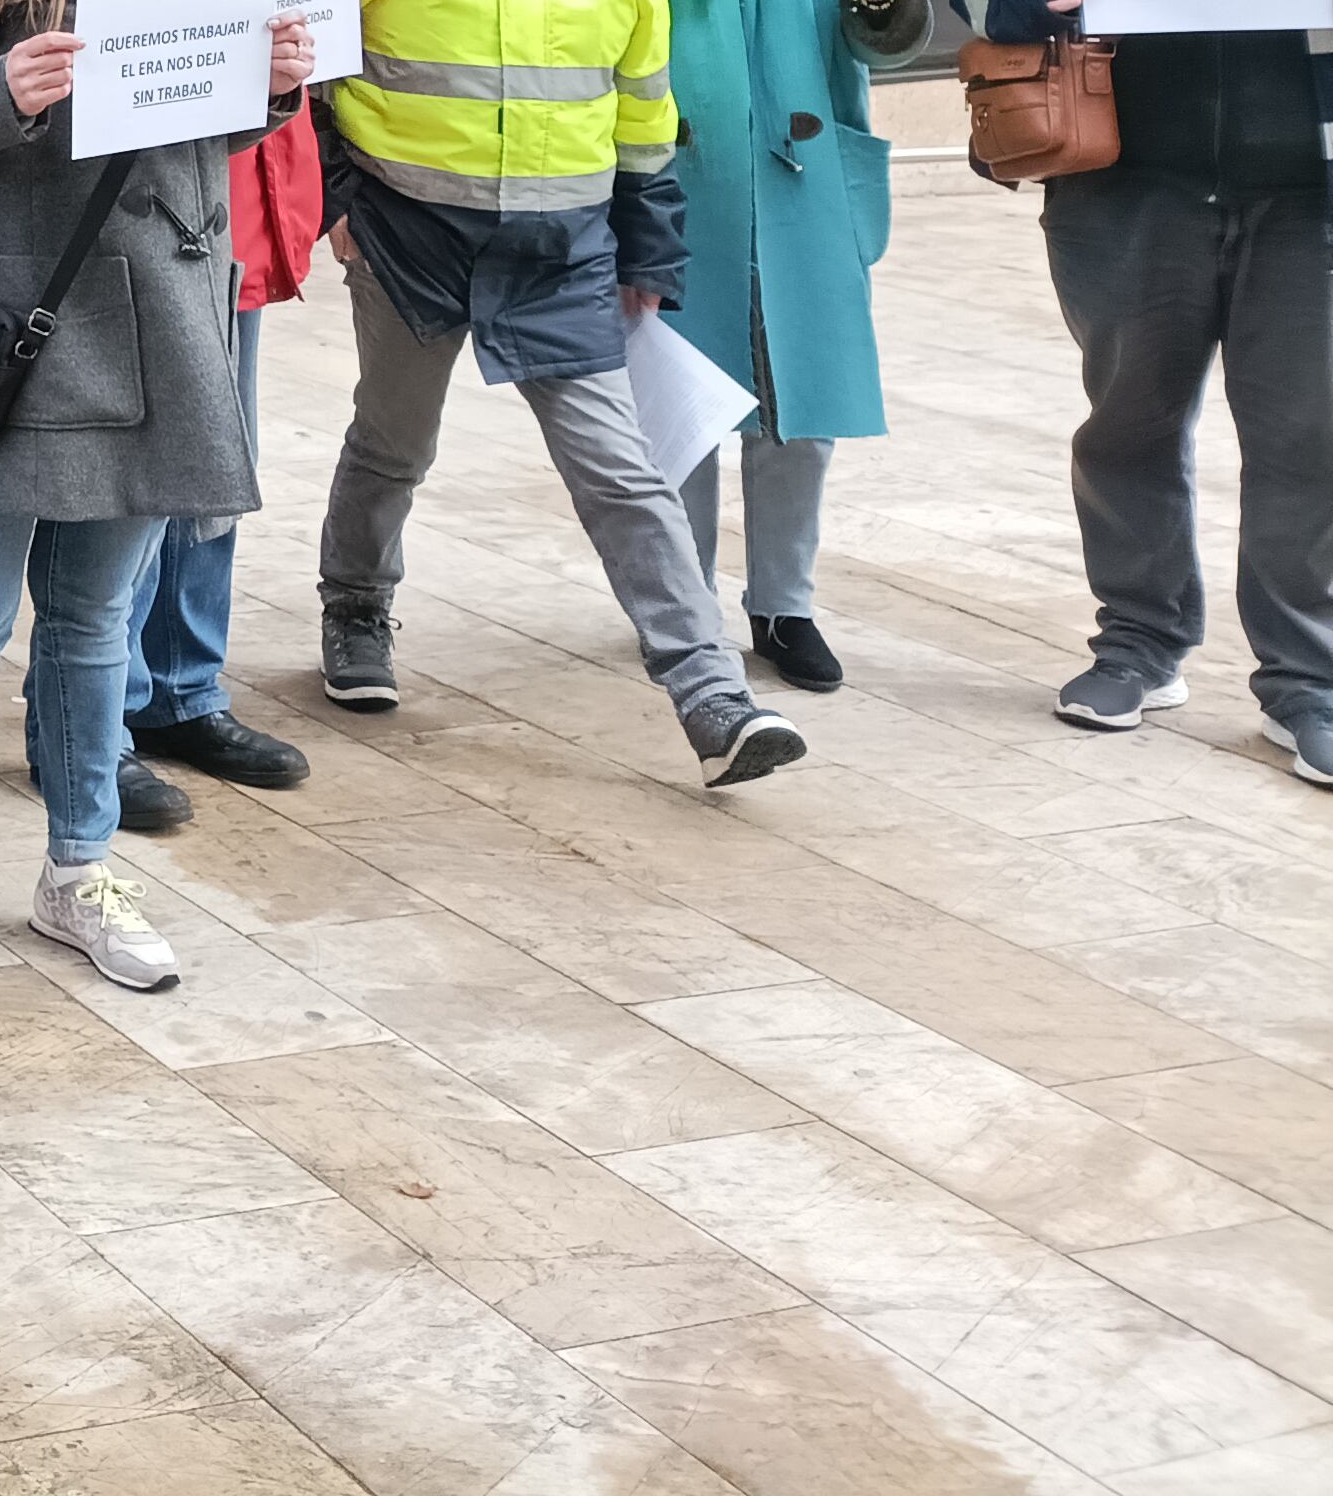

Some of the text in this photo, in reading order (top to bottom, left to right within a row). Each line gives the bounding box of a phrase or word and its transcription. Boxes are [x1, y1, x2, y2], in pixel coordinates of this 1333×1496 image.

[99, 19, 250, 55] ¡QUEREMOS TRABAJAR!
[121, 51, 226, 78] EL ERA NOS DEJA
[133, 80, 213, 105] SIN TRABAJO
